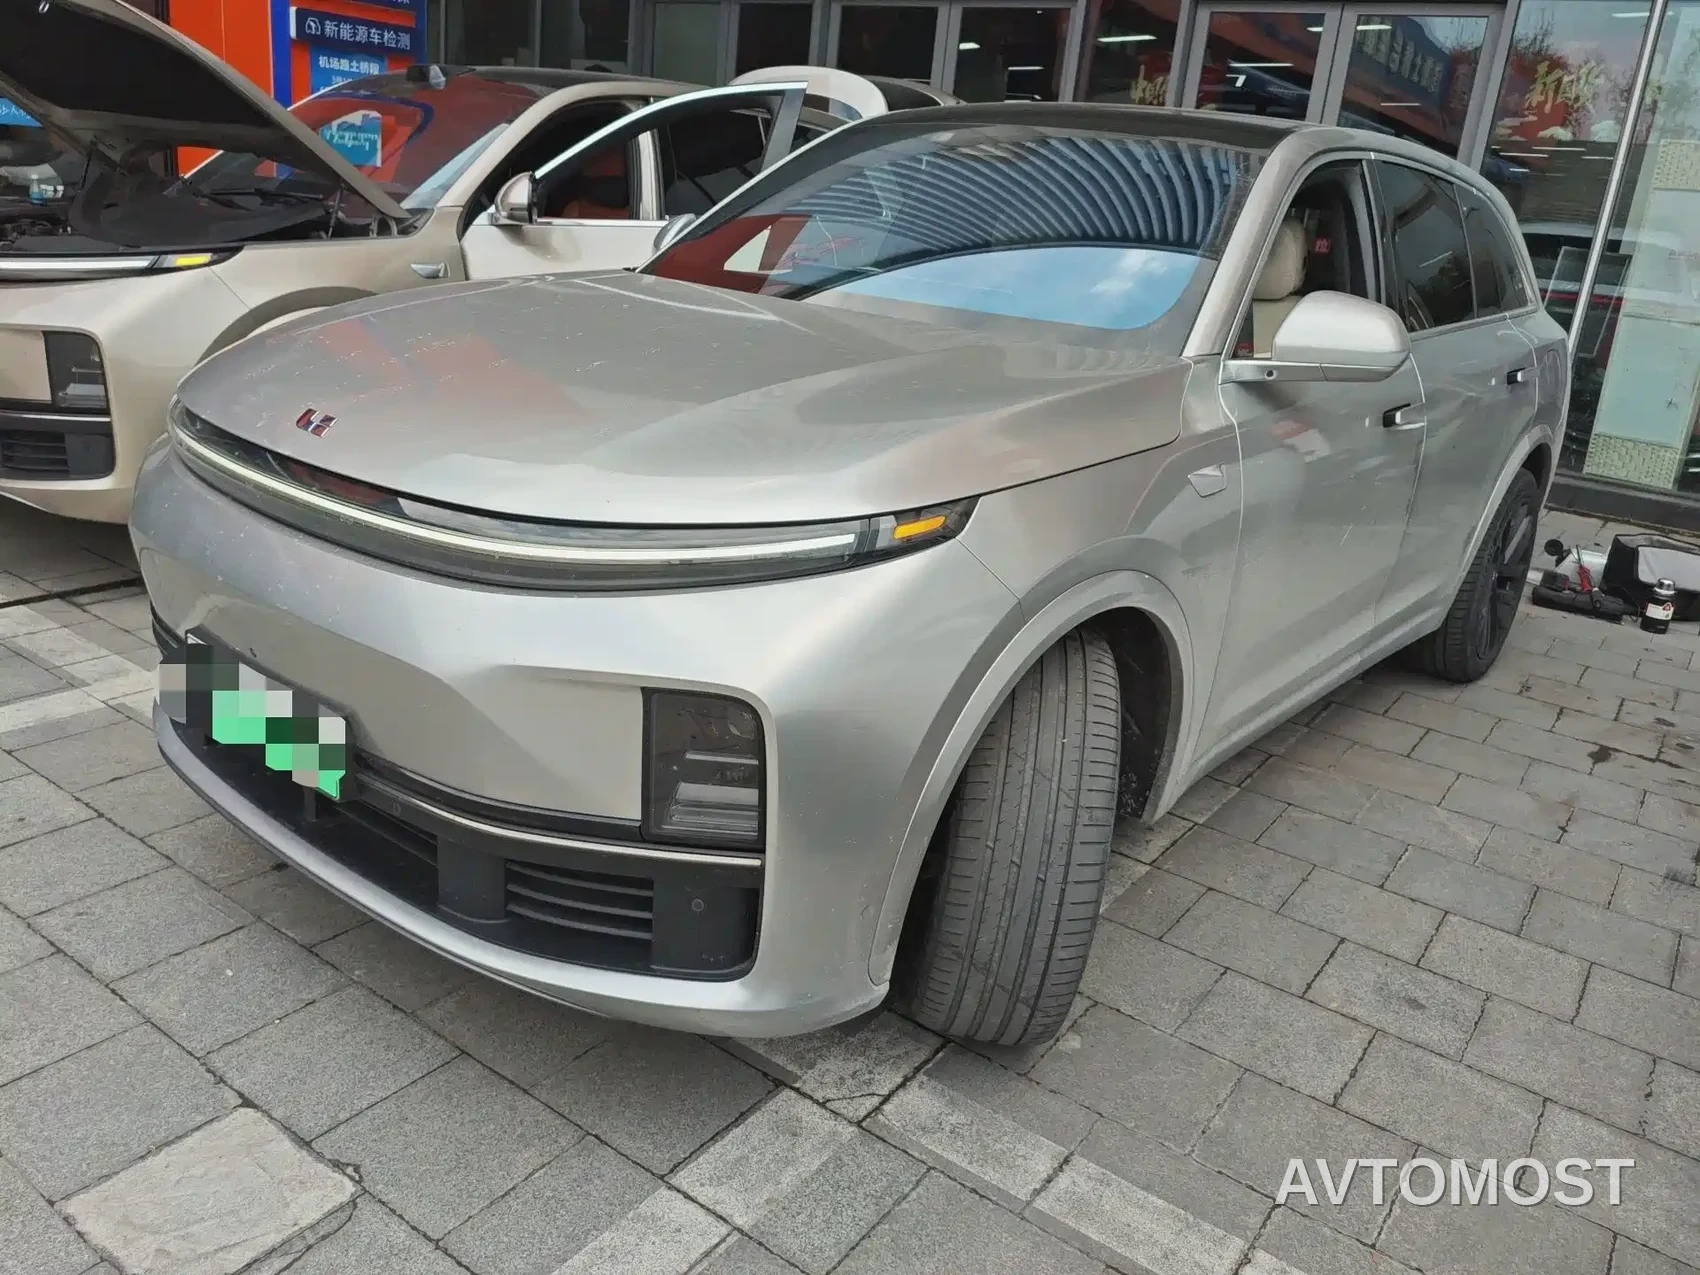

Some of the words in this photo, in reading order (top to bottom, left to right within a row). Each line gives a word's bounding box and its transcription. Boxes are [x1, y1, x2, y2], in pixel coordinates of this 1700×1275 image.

[324, 20, 411, 50] 新能源车检测
